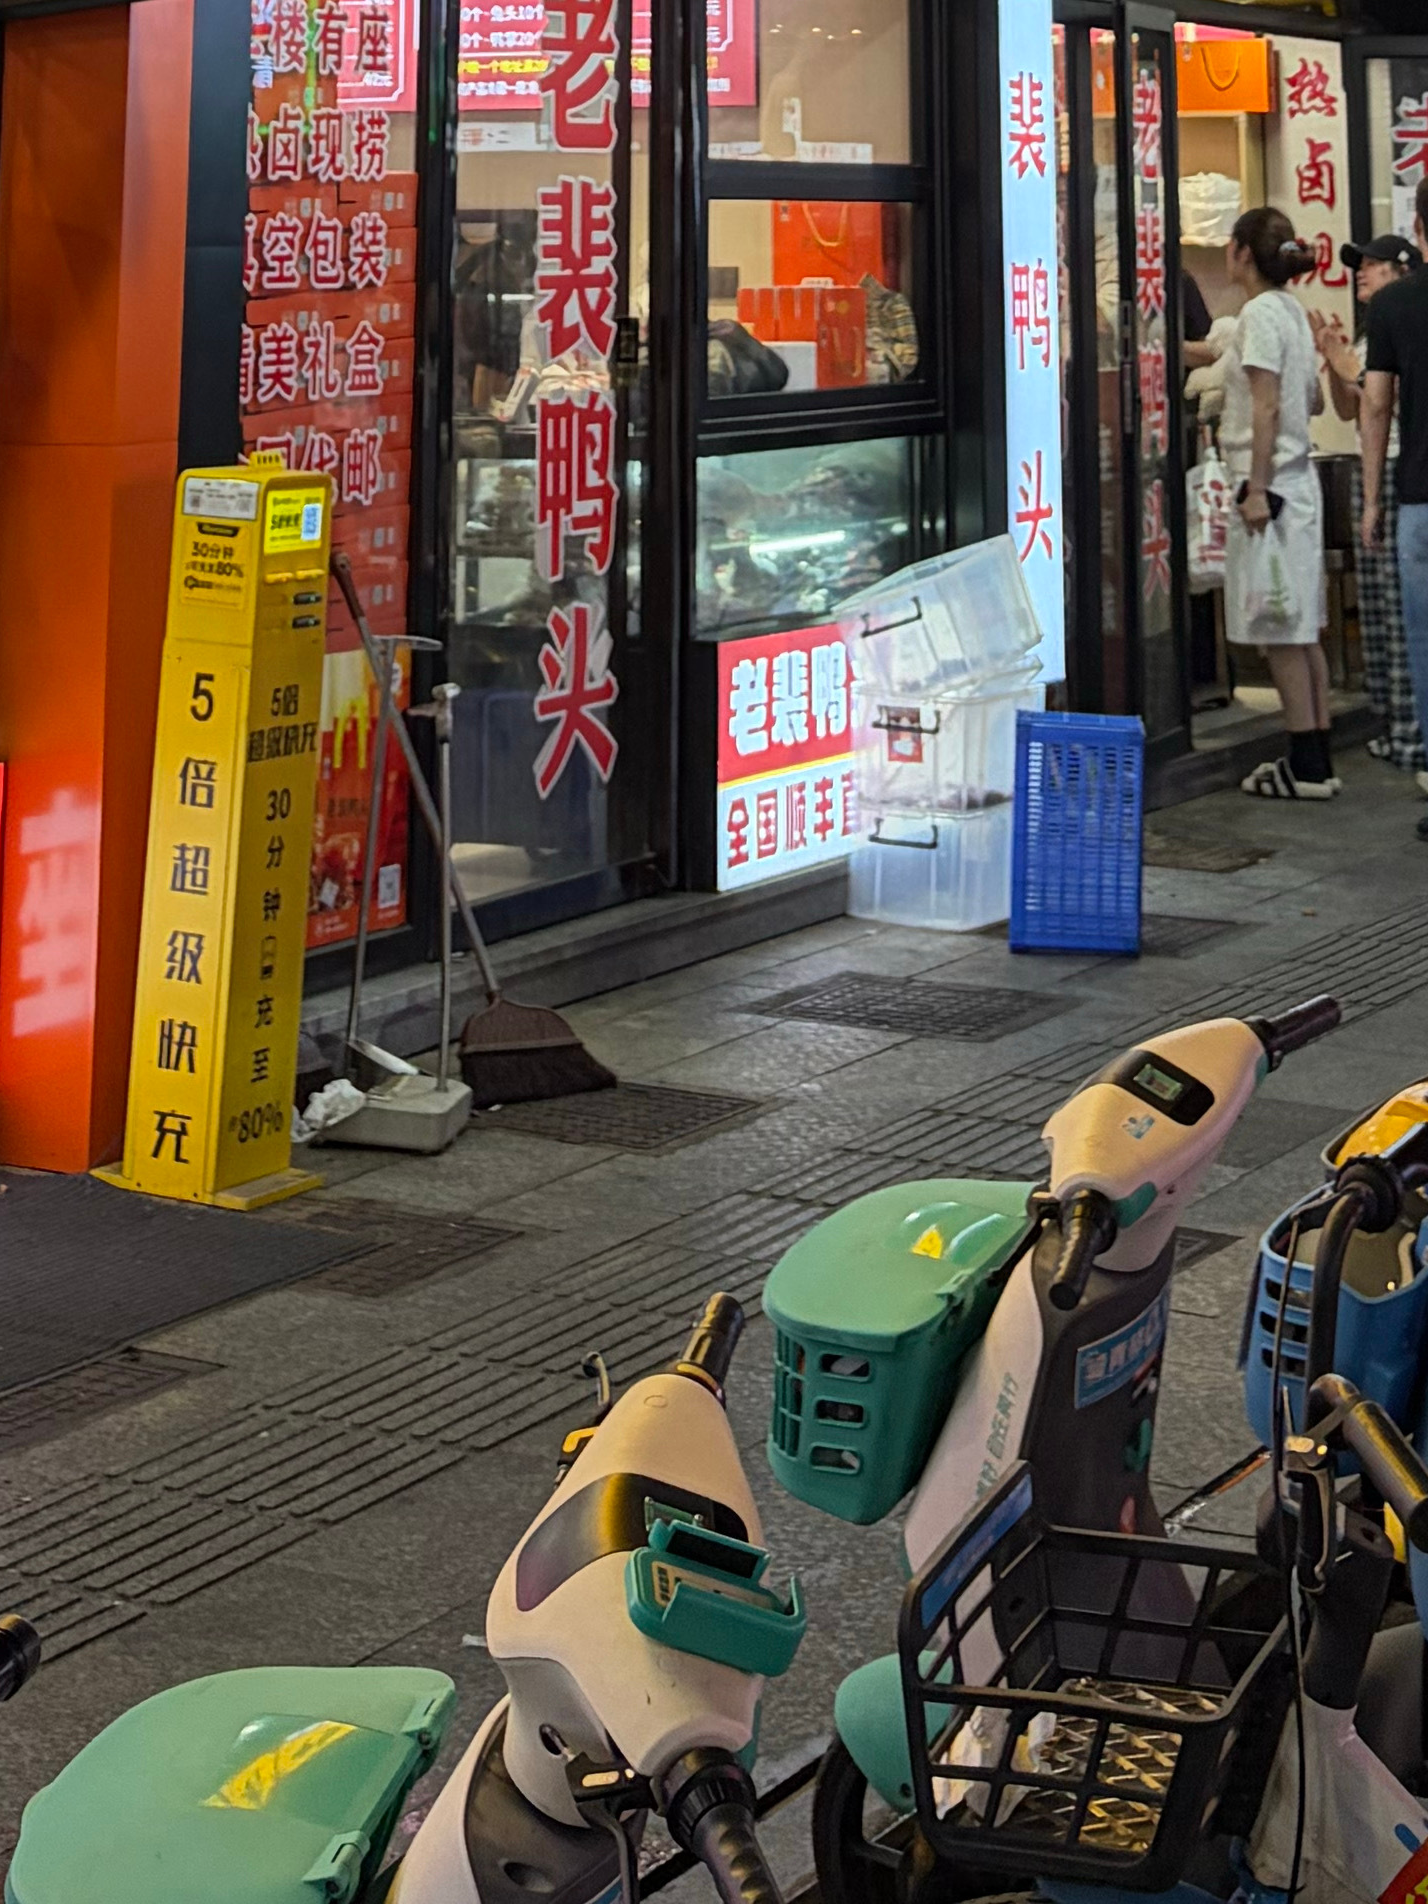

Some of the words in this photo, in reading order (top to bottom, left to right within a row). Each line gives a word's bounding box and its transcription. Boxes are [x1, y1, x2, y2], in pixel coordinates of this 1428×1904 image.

[269, 682, 300, 718] 5倍
[247, 719, 318, 765] 超级快充
[149, 671, 219, 1166] 5倍超级快充
